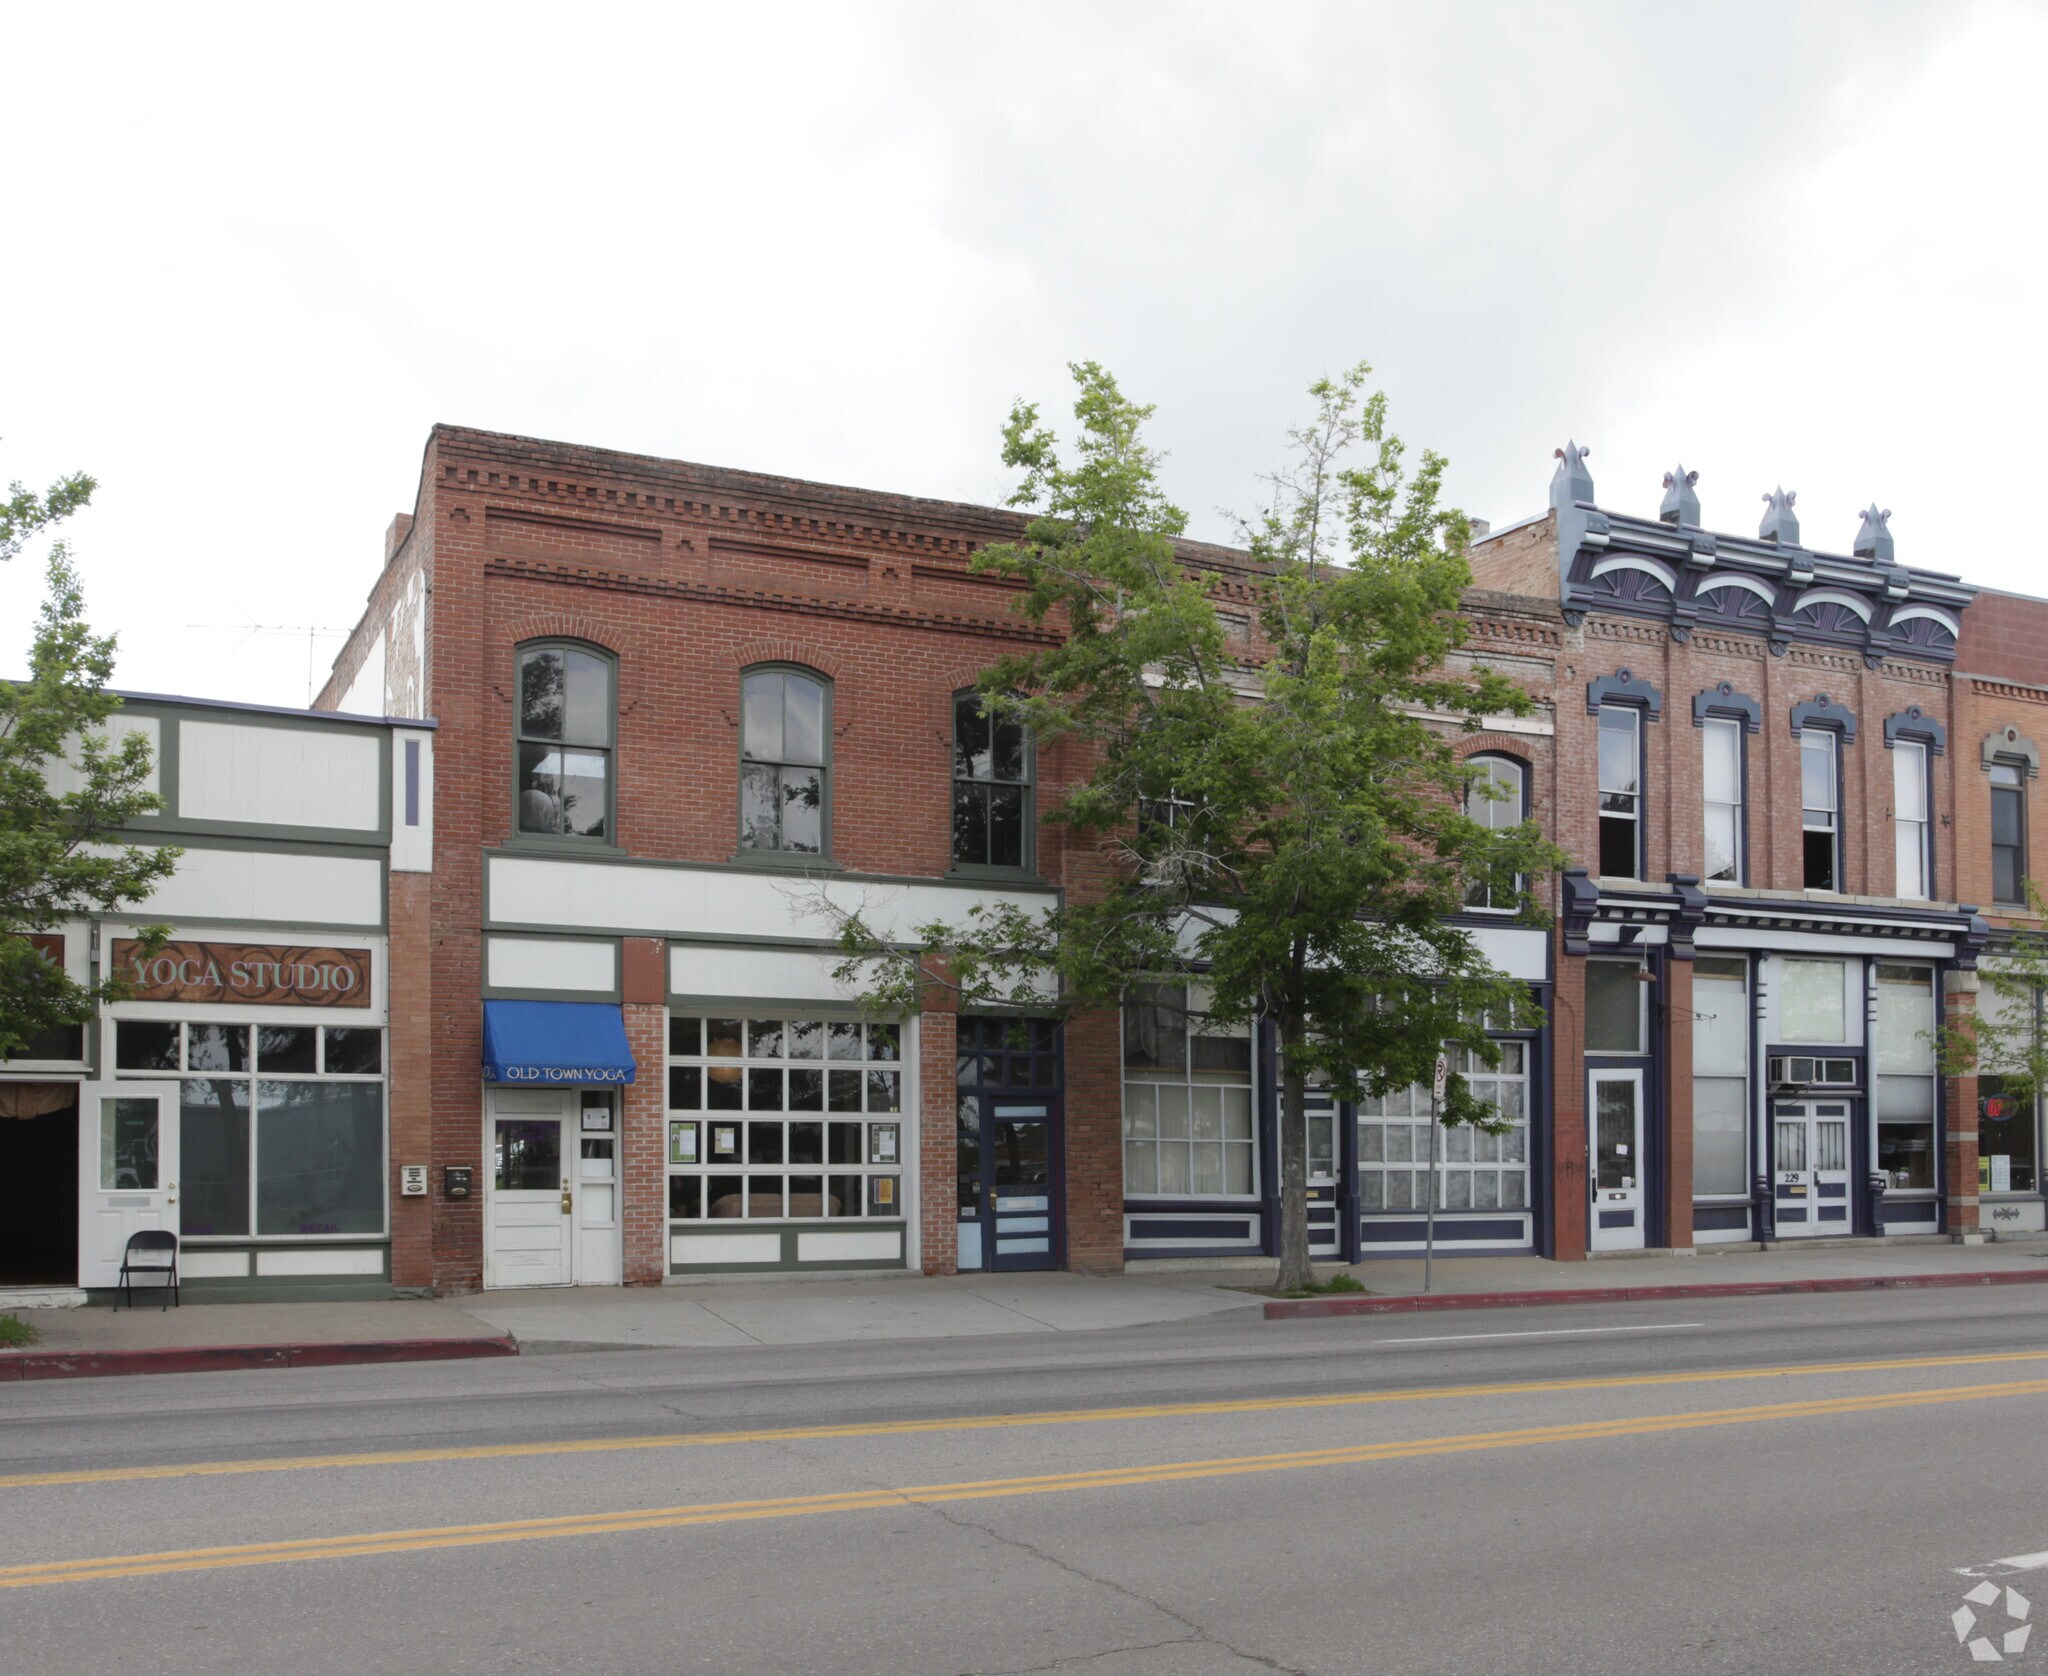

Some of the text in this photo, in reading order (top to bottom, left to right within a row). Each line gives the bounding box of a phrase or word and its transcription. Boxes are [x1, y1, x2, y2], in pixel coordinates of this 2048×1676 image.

[130, 957, 355, 992] YOGA STUDIO
[507, 1066, 540, 1080] OLD
[542, 1067, 582, 1081] TOWN
[585, 1068, 626, 1081] YOGA
[1784, 1173, 1800, 1183] 229
[302, 1224, 340, 1233] RETAIL
